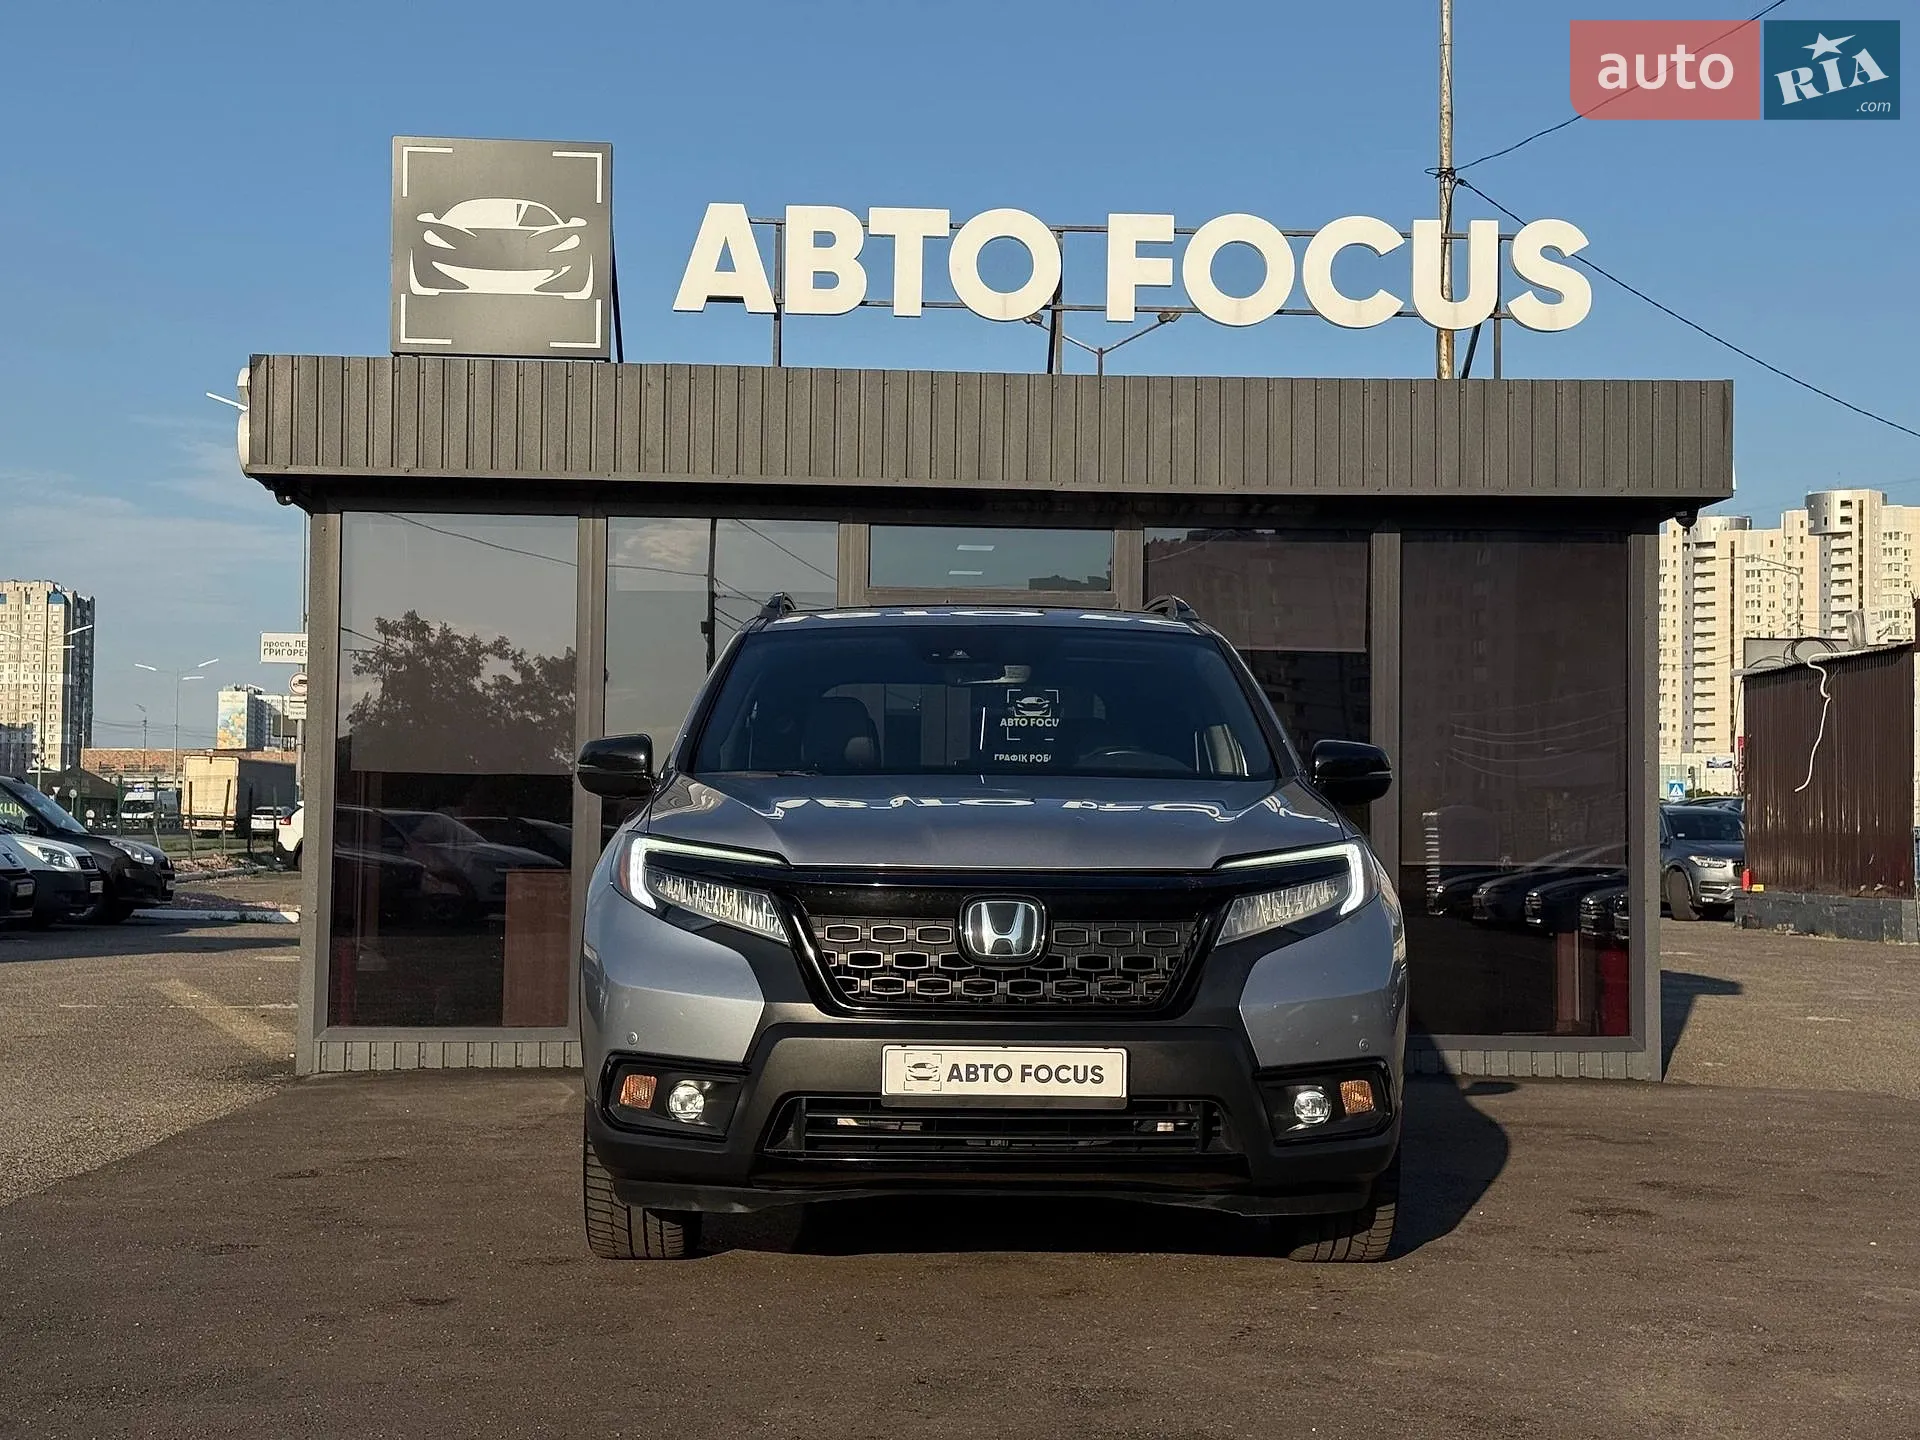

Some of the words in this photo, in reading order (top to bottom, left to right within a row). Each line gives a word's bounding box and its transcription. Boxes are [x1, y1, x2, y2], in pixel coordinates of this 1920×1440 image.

[673, 202, 1062, 322] АВТО
[1105, 212, 1593, 333] FOCUS
[999, 718, 1028, 727] АВТО
[994, 753, 1028, 763] ГРАФІК
[1029, 753, 1052, 763] РОБ
[946, 1063, 1013, 1084] АВТО
[1020, 1064, 1105, 1085] FOCUS
